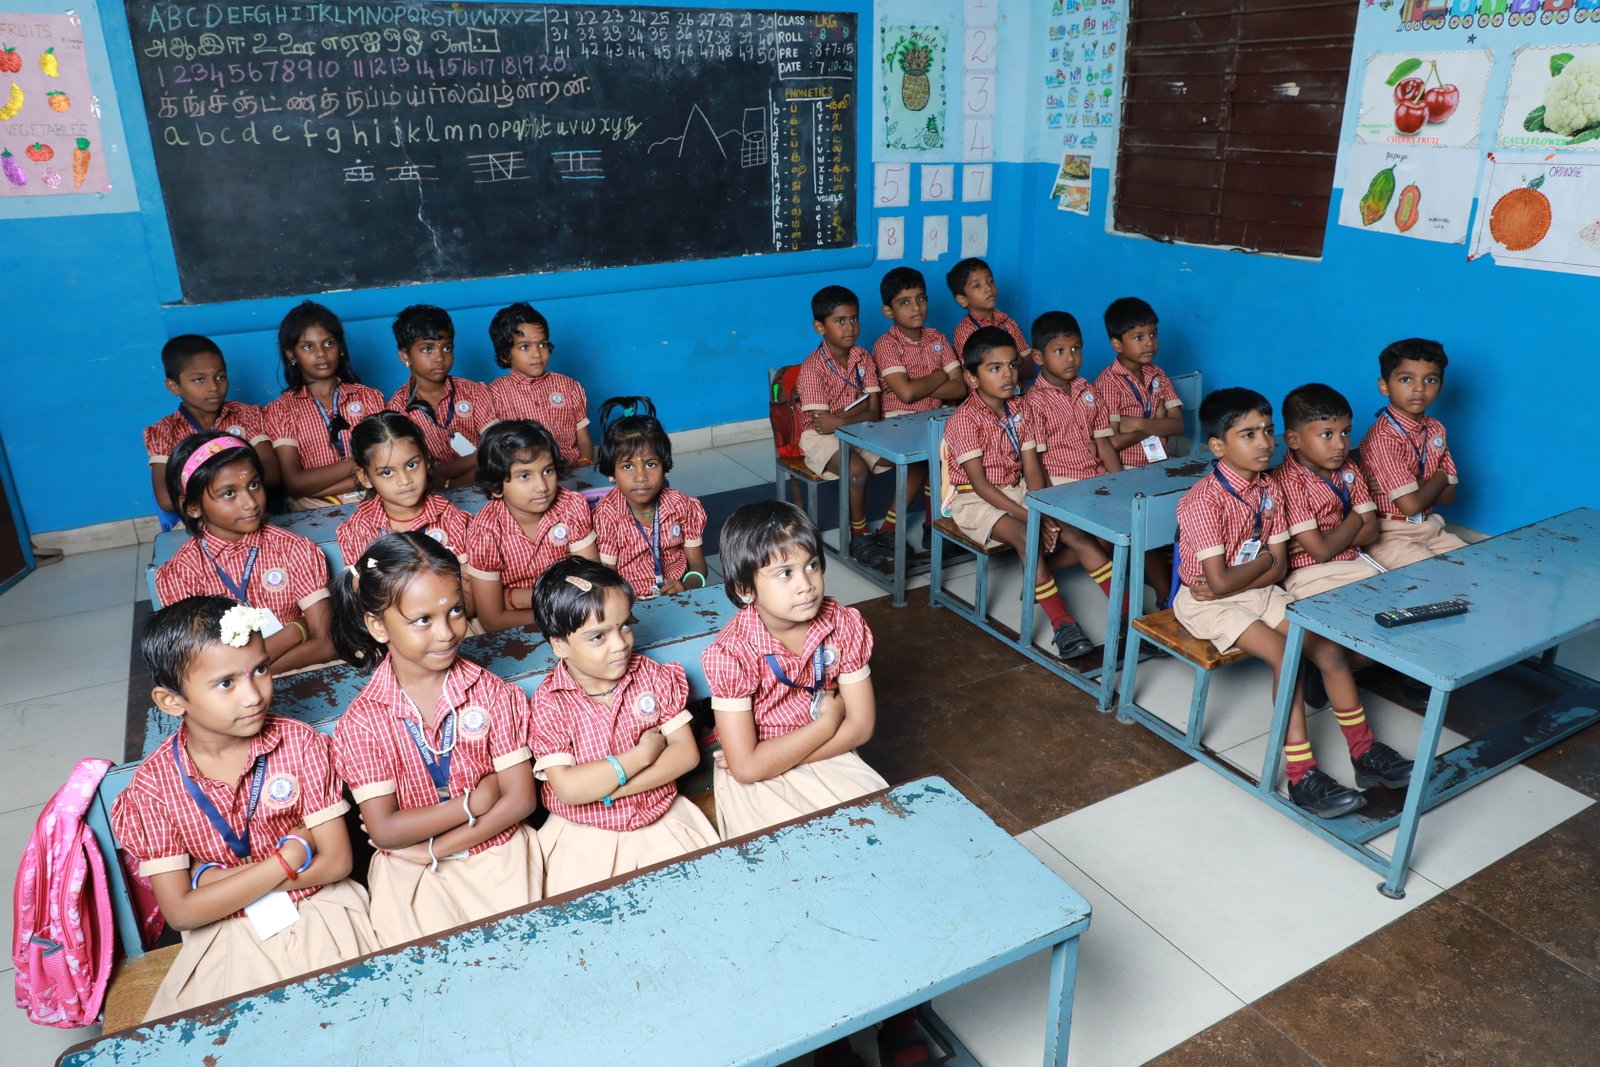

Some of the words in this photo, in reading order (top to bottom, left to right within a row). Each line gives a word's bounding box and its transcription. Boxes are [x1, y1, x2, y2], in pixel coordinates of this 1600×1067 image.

[777, 15, 806, 26] CLASS
[815, 14, 837, 28] LKG
[0, 23, 52, 38] FRUITS
[778, 31, 804, 44] ROLL
[779, 48, 798, 59] PRE
[972, 30, 989, 63] 2
[779, 62, 802, 73] DATE
[785, 86, 833, 98] PHONETICS
[967, 77, 989, 112] 3
[3, 123, 88, 137] VEGETABLES
[970, 122, 990, 157] 4
[1387, 136, 1415, 144] CHERRY
[1549, 166, 1583, 177] ORANGE
[881, 167, 905, 203] 5
[929, 169, 943, 198] 6
[971, 171, 985, 196] 7
[887, 227, 897, 245] 8
[930, 229, 939, 246] 9
[968, 231, 979, 243] 10
